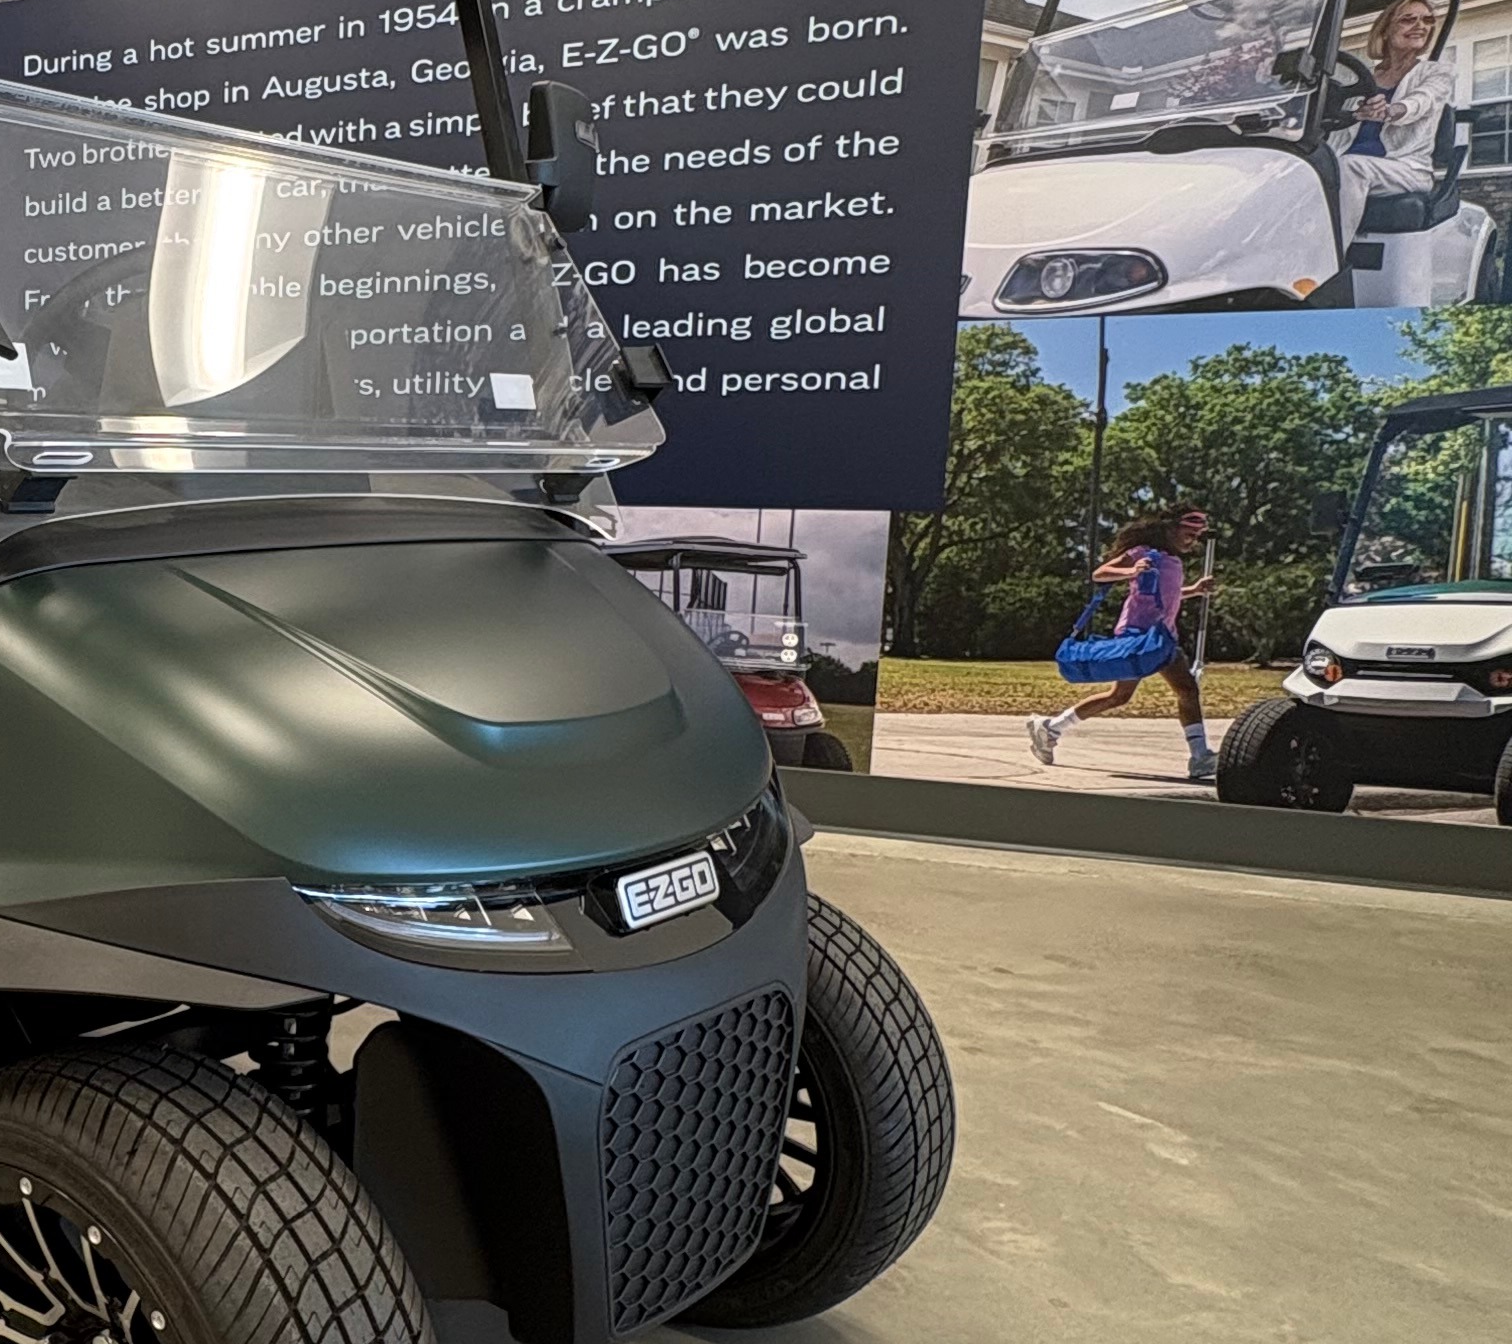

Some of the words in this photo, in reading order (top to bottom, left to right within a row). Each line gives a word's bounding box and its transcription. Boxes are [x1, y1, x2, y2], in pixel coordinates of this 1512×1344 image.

[24, 50, 112, 76] During
[123, 49, 138, 64] a
[150, 38, 194, 61] hot
[207, 25, 325, 54] summer
[339, 16, 364, 38] in
[379, 2, 458, 33] 1954
[492, 2, 509, 18] n
[143, 86, 210, 112] shop
[224, 82, 248, 103] in
[262, 68, 395, 99] Augusta,
[411, 49, 545, 83] Geoia,
[716, 27, 788, 51] was
[808, 16, 907, 42] born.
[24, 148, 75, 169] Two
[308, 116, 377, 147] with
[385, 122, 401, 138] a
[410, 112, 481, 136] simp
[623, 90, 695, 117] that
[704, 84, 787, 110] they
[798, 68, 903, 102] could
[26, 191, 86, 216] build
[97, 196, 111, 210] a
[120, 187, 201, 210] better
[276, 177, 328, 199] car,
[595, 148, 650, 175] the
[664, 139, 770, 170] needs
[785, 135, 822, 161] of
[836, 131, 899, 157] the
[254, 228, 291, 253] ny
[303, 221, 385, 247] other
[397, 213, 505, 240] vehicle
[615, 210, 656, 229] on
[674, 200, 731, 225] the
[751, 192, 893, 221] market.
[320, 269, 495, 298] beginnings,
[659, 258, 720, 282] has
[745, 254, 890, 278] become
[586, 319, 606, 340] a
[624, 312, 752, 340] leading
[770, 306, 884, 339] global
[393, 372, 484, 397] utility
[673, 368, 706, 391] nd
[722, 364, 880, 396] personal
